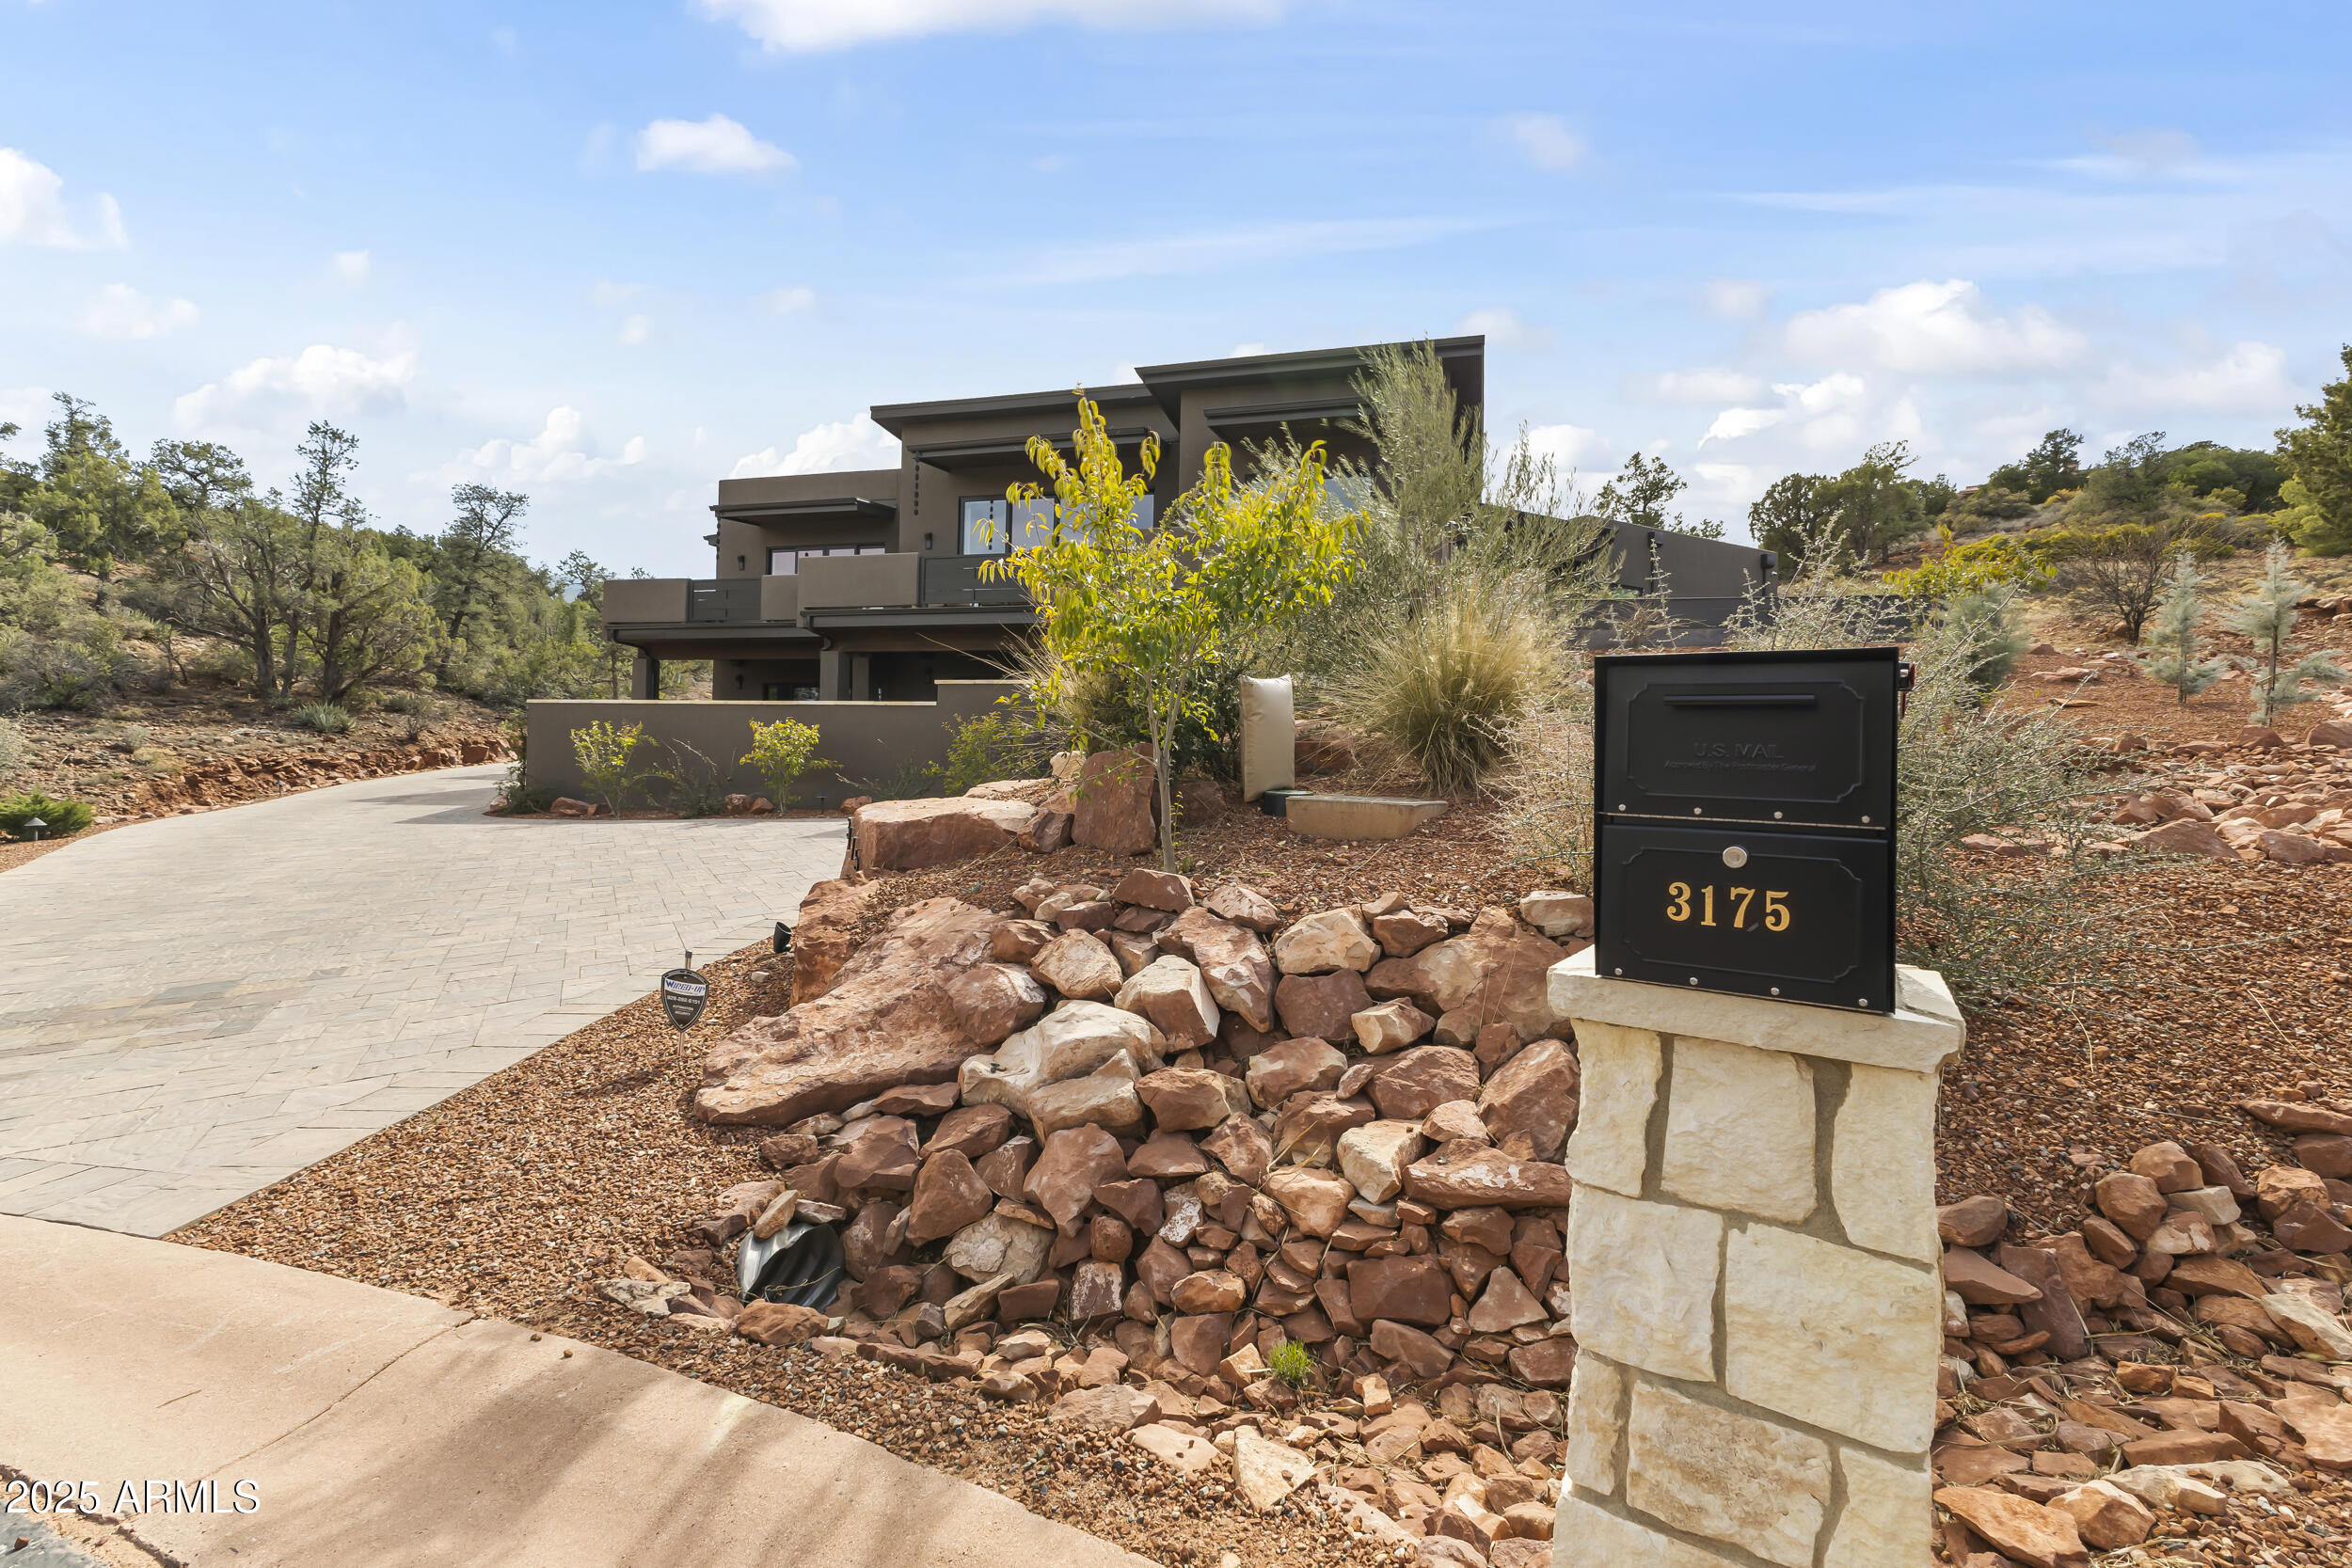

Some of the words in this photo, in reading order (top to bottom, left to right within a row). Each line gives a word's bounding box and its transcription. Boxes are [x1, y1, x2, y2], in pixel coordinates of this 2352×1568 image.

[1693, 743, 1730, 758] U.S.
[1735, 743, 1784, 759] MAIL
[1667, 882, 1789, 931] 3175
